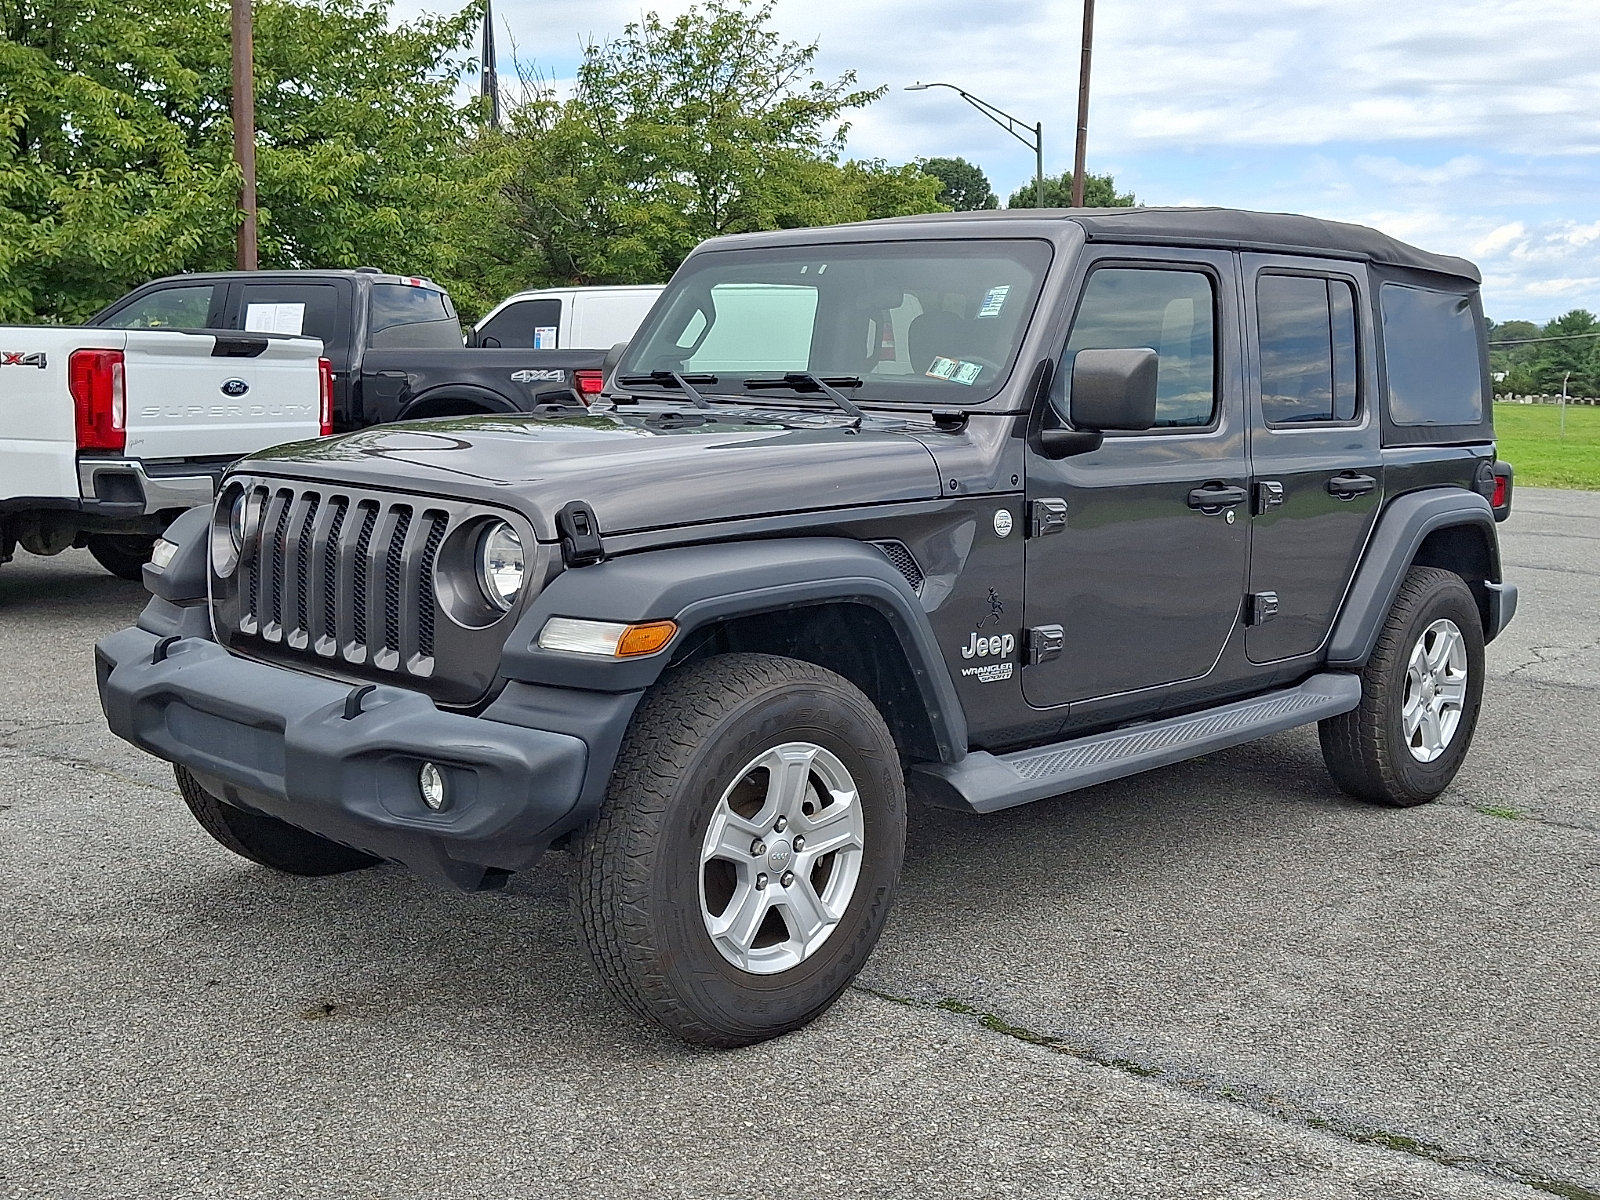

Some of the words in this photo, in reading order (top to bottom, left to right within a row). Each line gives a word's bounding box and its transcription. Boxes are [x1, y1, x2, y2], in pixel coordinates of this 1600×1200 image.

[0, 351, 47, 369] X4
[228, 381, 245, 393] Ford
[140, 406, 243, 418] SUPER
[251, 404, 312, 416] DUTY
[961, 632, 1015, 659] Jeep
[961, 662, 1013, 677] WRANGLER
